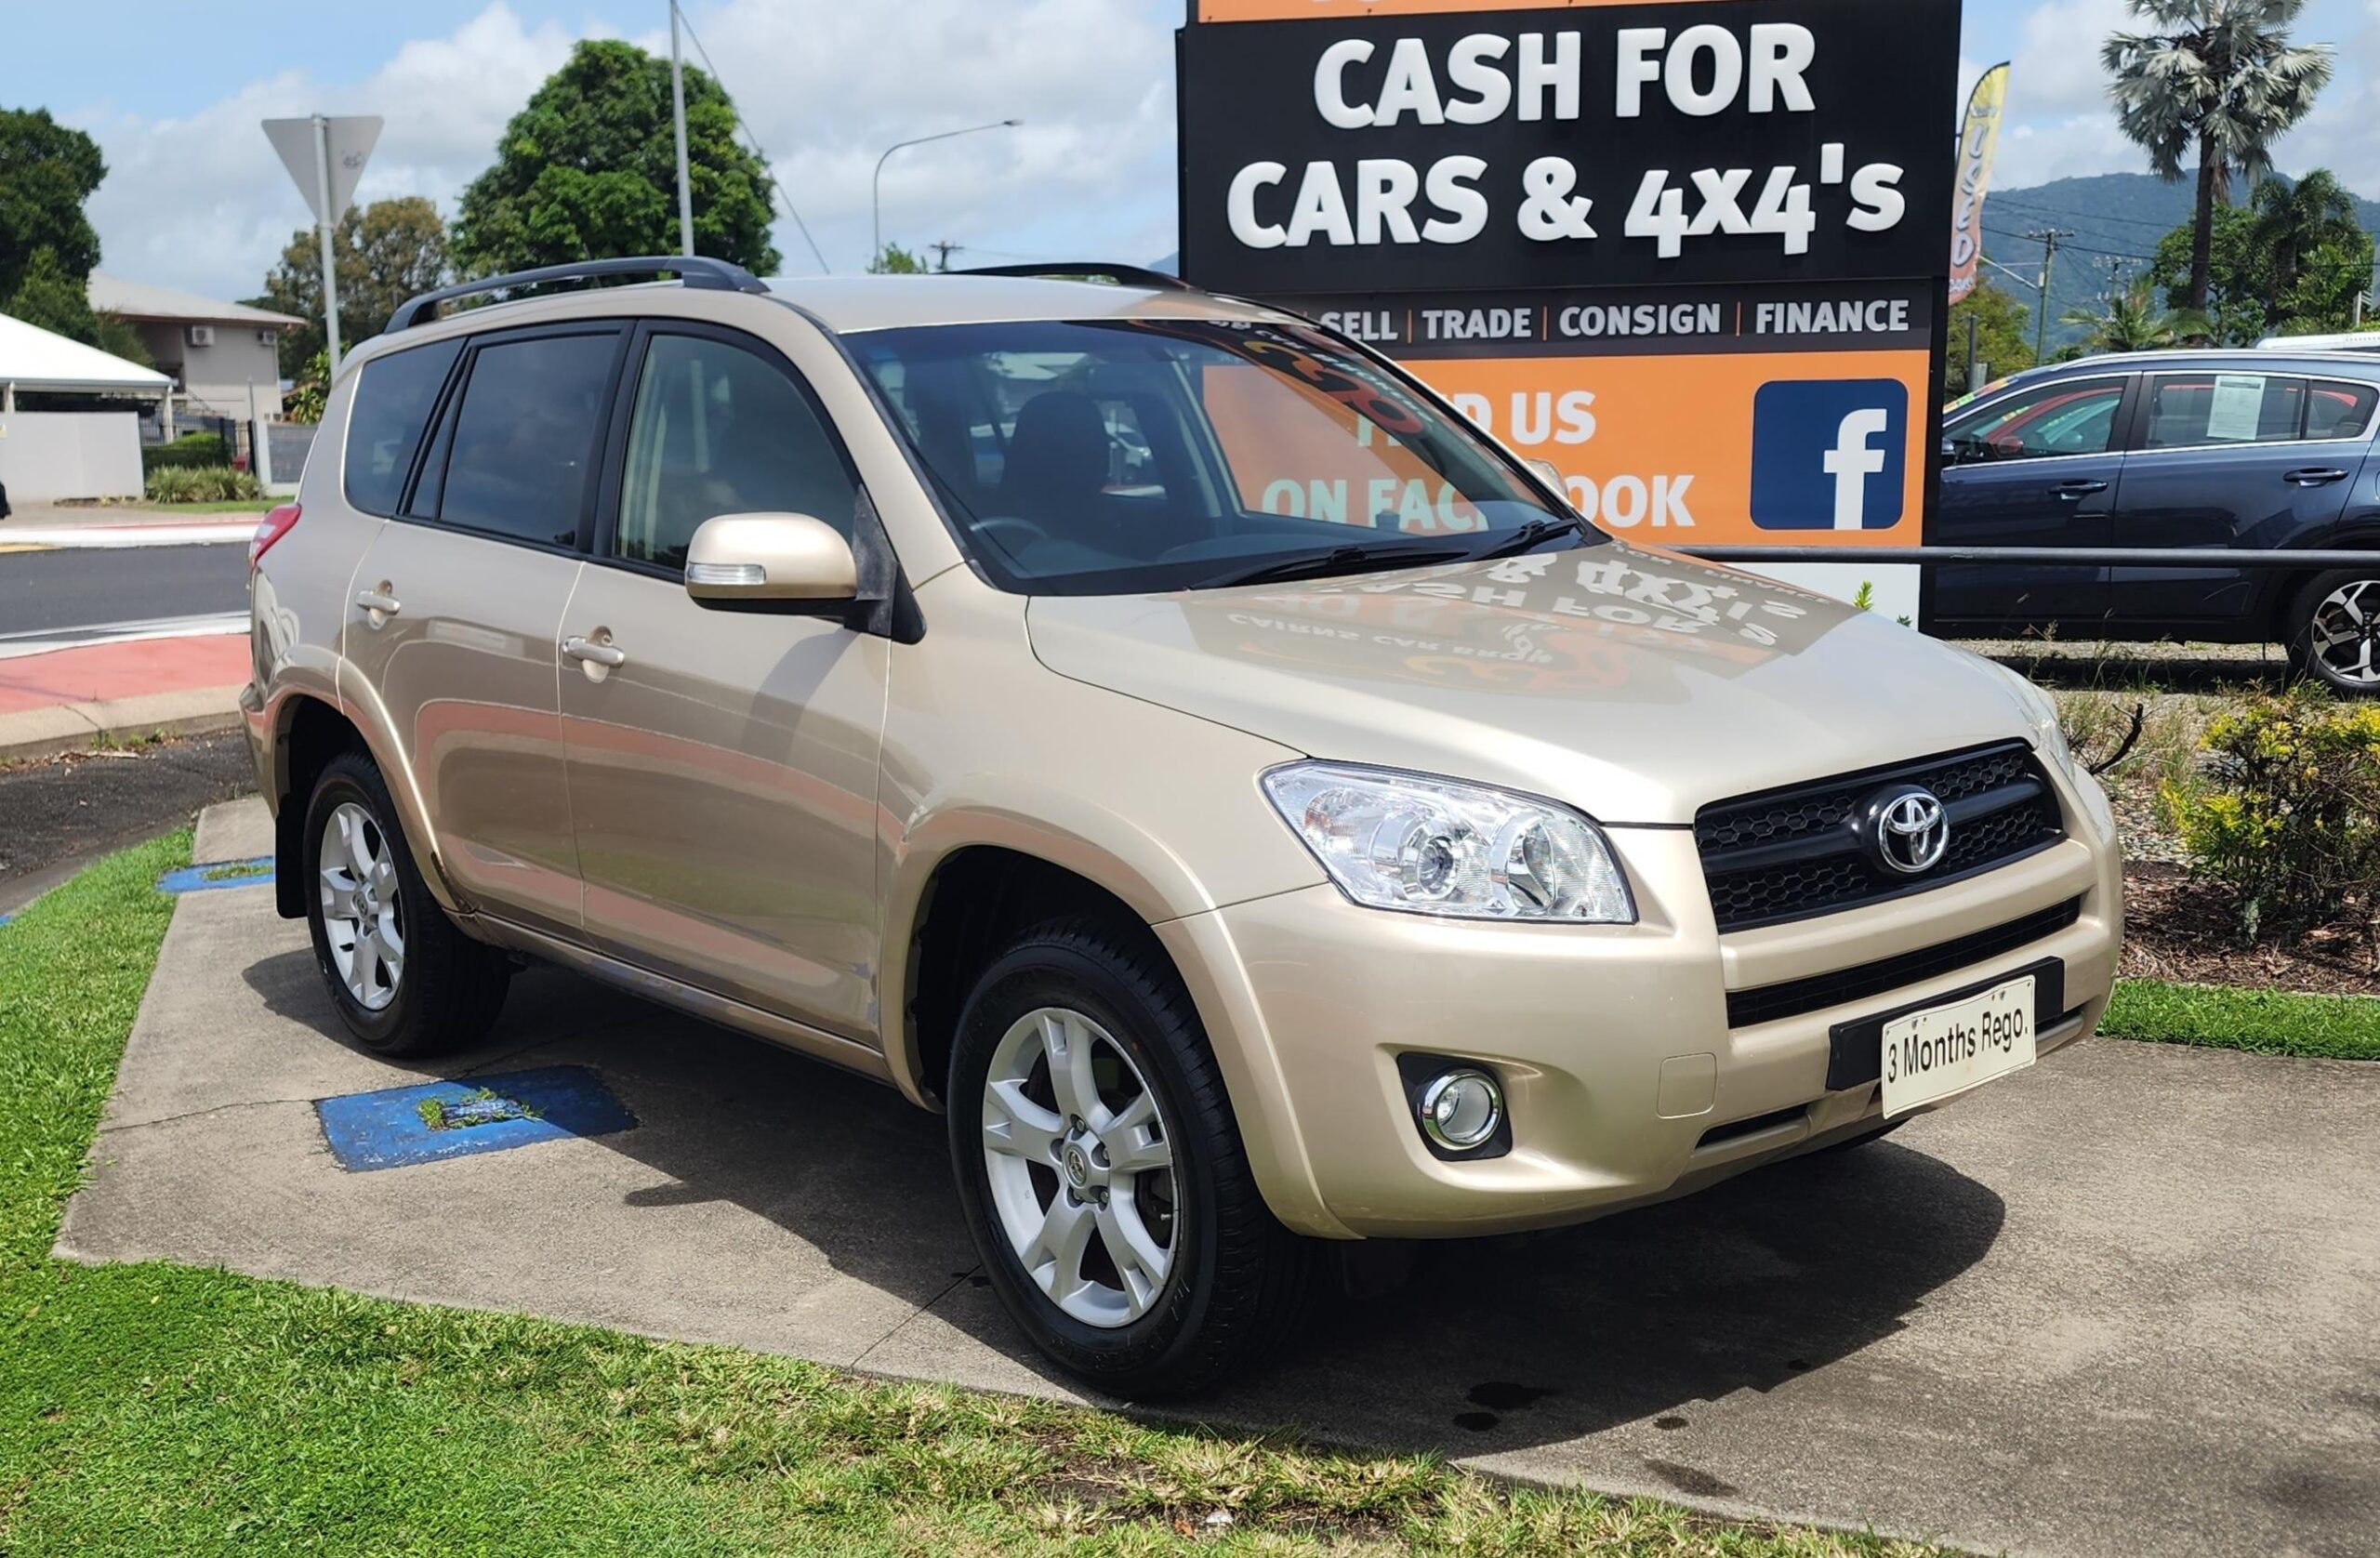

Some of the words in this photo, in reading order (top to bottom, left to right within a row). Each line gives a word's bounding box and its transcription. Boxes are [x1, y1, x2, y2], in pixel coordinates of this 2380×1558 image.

[1314, 31, 1581, 129] CASH
[1616, 23, 1817, 118] FOR
[1227, 155, 1489, 249] CARS
[1517, 156, 1598, 241] &
[1319, 310, 1398, 341] SELL
[1421, 308, 1532, 339] TRADE
[1559, 303, 1721, 337] CONSIGN
[1755, 300, 1909, 334] FINANCE
[1511, 390, 1596, 445] US
[1262, 478, 1347, 523] ON
[1887, 1043, 1898, 1084] 3
[1903, 1023, 1977, 1078] Months
[1981, 1008, 2029, 1053] Rego.
